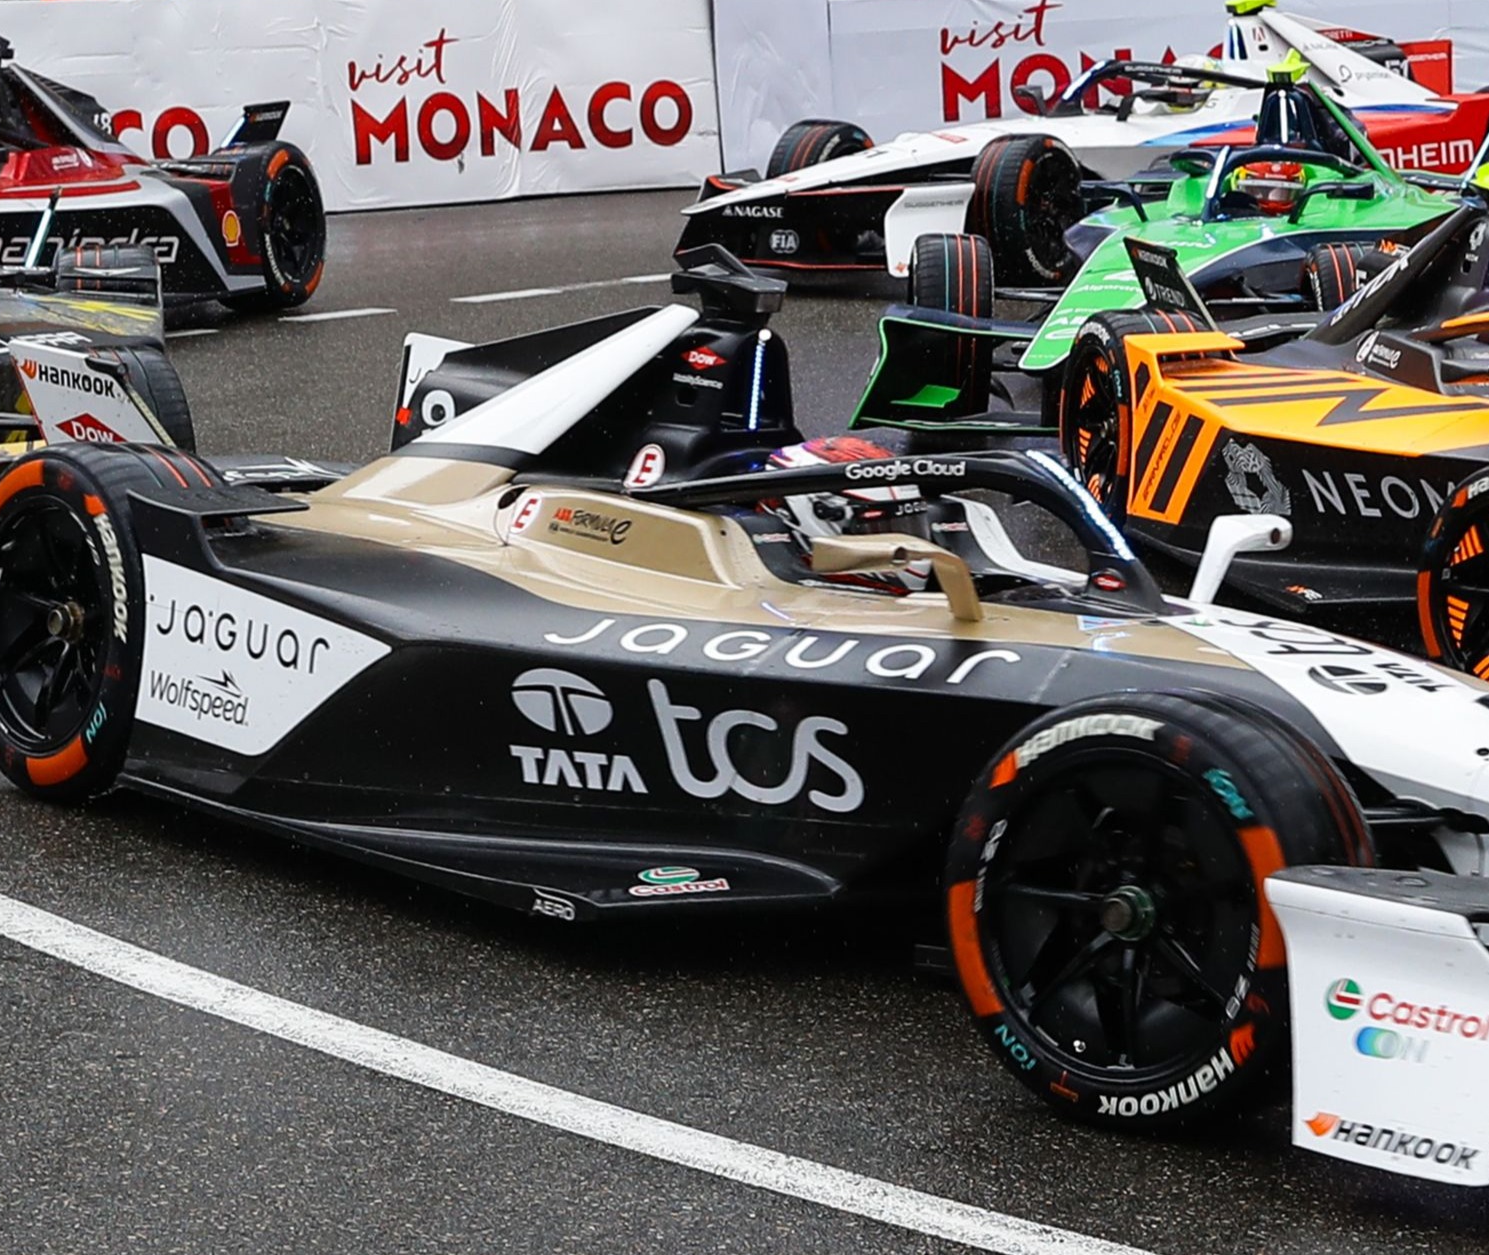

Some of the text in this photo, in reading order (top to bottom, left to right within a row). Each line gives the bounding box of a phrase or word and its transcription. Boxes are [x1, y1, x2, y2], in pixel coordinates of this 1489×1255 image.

[348, 28, 458, 93] visit
[351, 80, 693, 166] MONACO
[735, 205, 784, 219] NAGASE
[1154, 283, 1185, 307] TREND
[36, 360, 117, 399] Hankook
[688, 350, 718, 366] Dow
[71, 421, 114, 443] Dow
[633, 453, 657, 484] E
[845, 459, 967, 481] Google Cloud
[514, 498, 538, 529] E
[92, 513, 128, 645] Hankook
[155, 597, 331, 675] JaGUar
[543, 617, 1022, 684] JaGUar
[149, 669, 249, 727] Wolfspeed
[510, 745, 649, 794] TATA
[647, 678, 866, 813] tcs
[531, 897, 576, 922] AERO
[628, 878, 731, 898] Castrol
[994, 1021, 1038, 1072] iON
[1096, 1047, 1236, 1117] Hankook
[1335, 1117, 1482, 1173] Hankook
